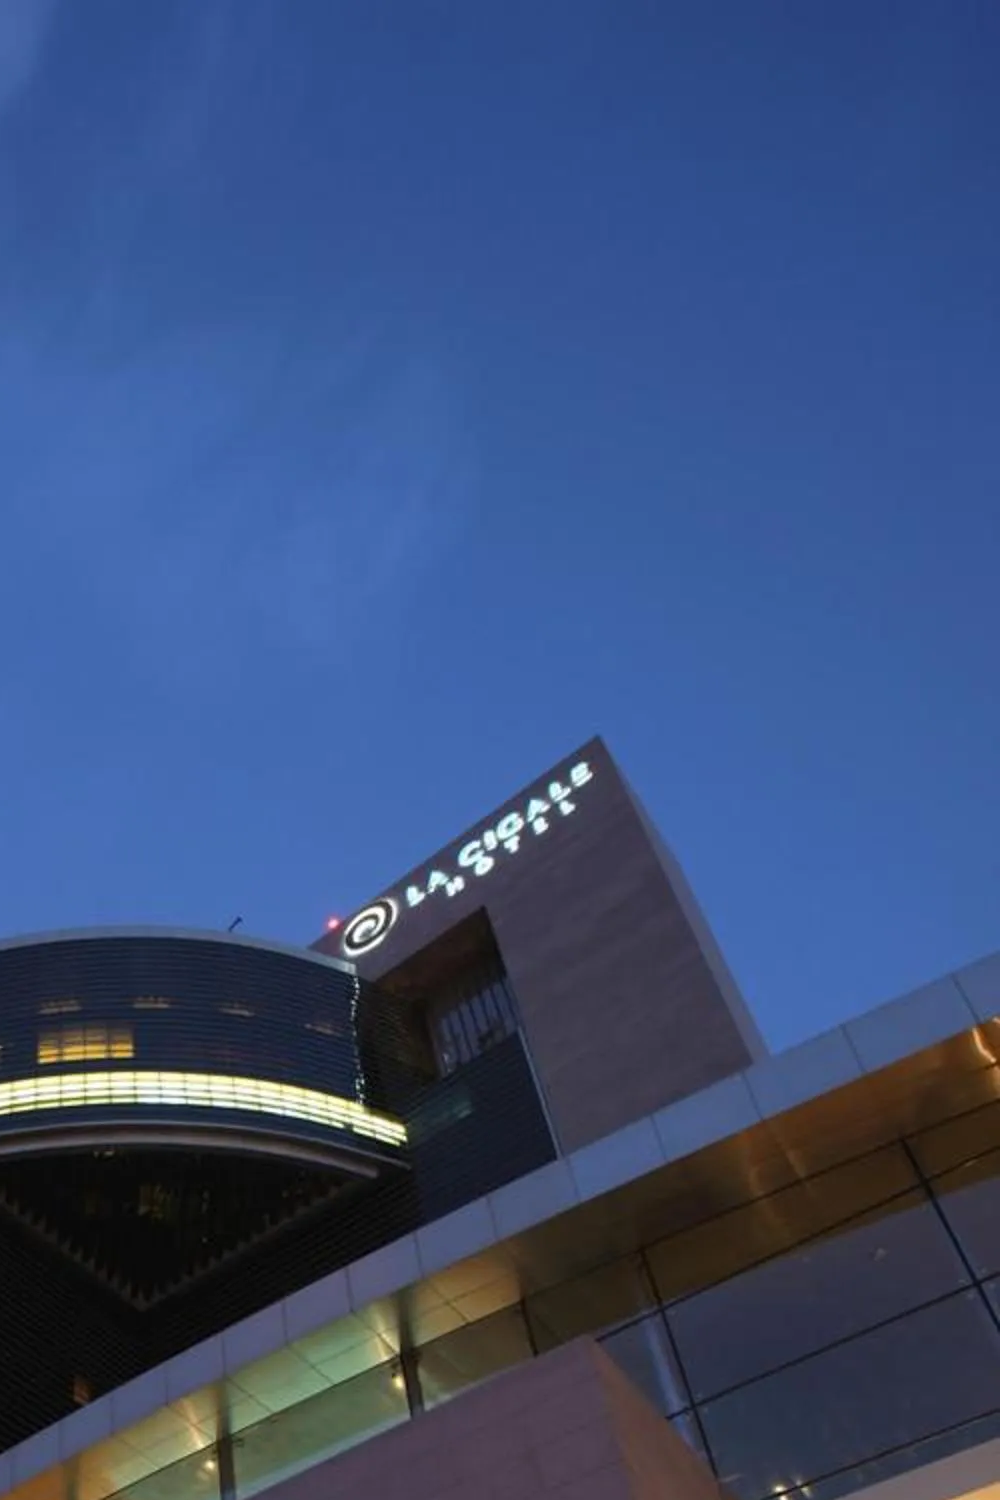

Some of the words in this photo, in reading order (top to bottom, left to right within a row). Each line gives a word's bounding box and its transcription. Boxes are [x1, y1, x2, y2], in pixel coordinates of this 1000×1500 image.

[405, 870, 449, 907] LA
[457, 760, 594, 868] CIGALE
[445, 800, 576, 897] HOTEL
